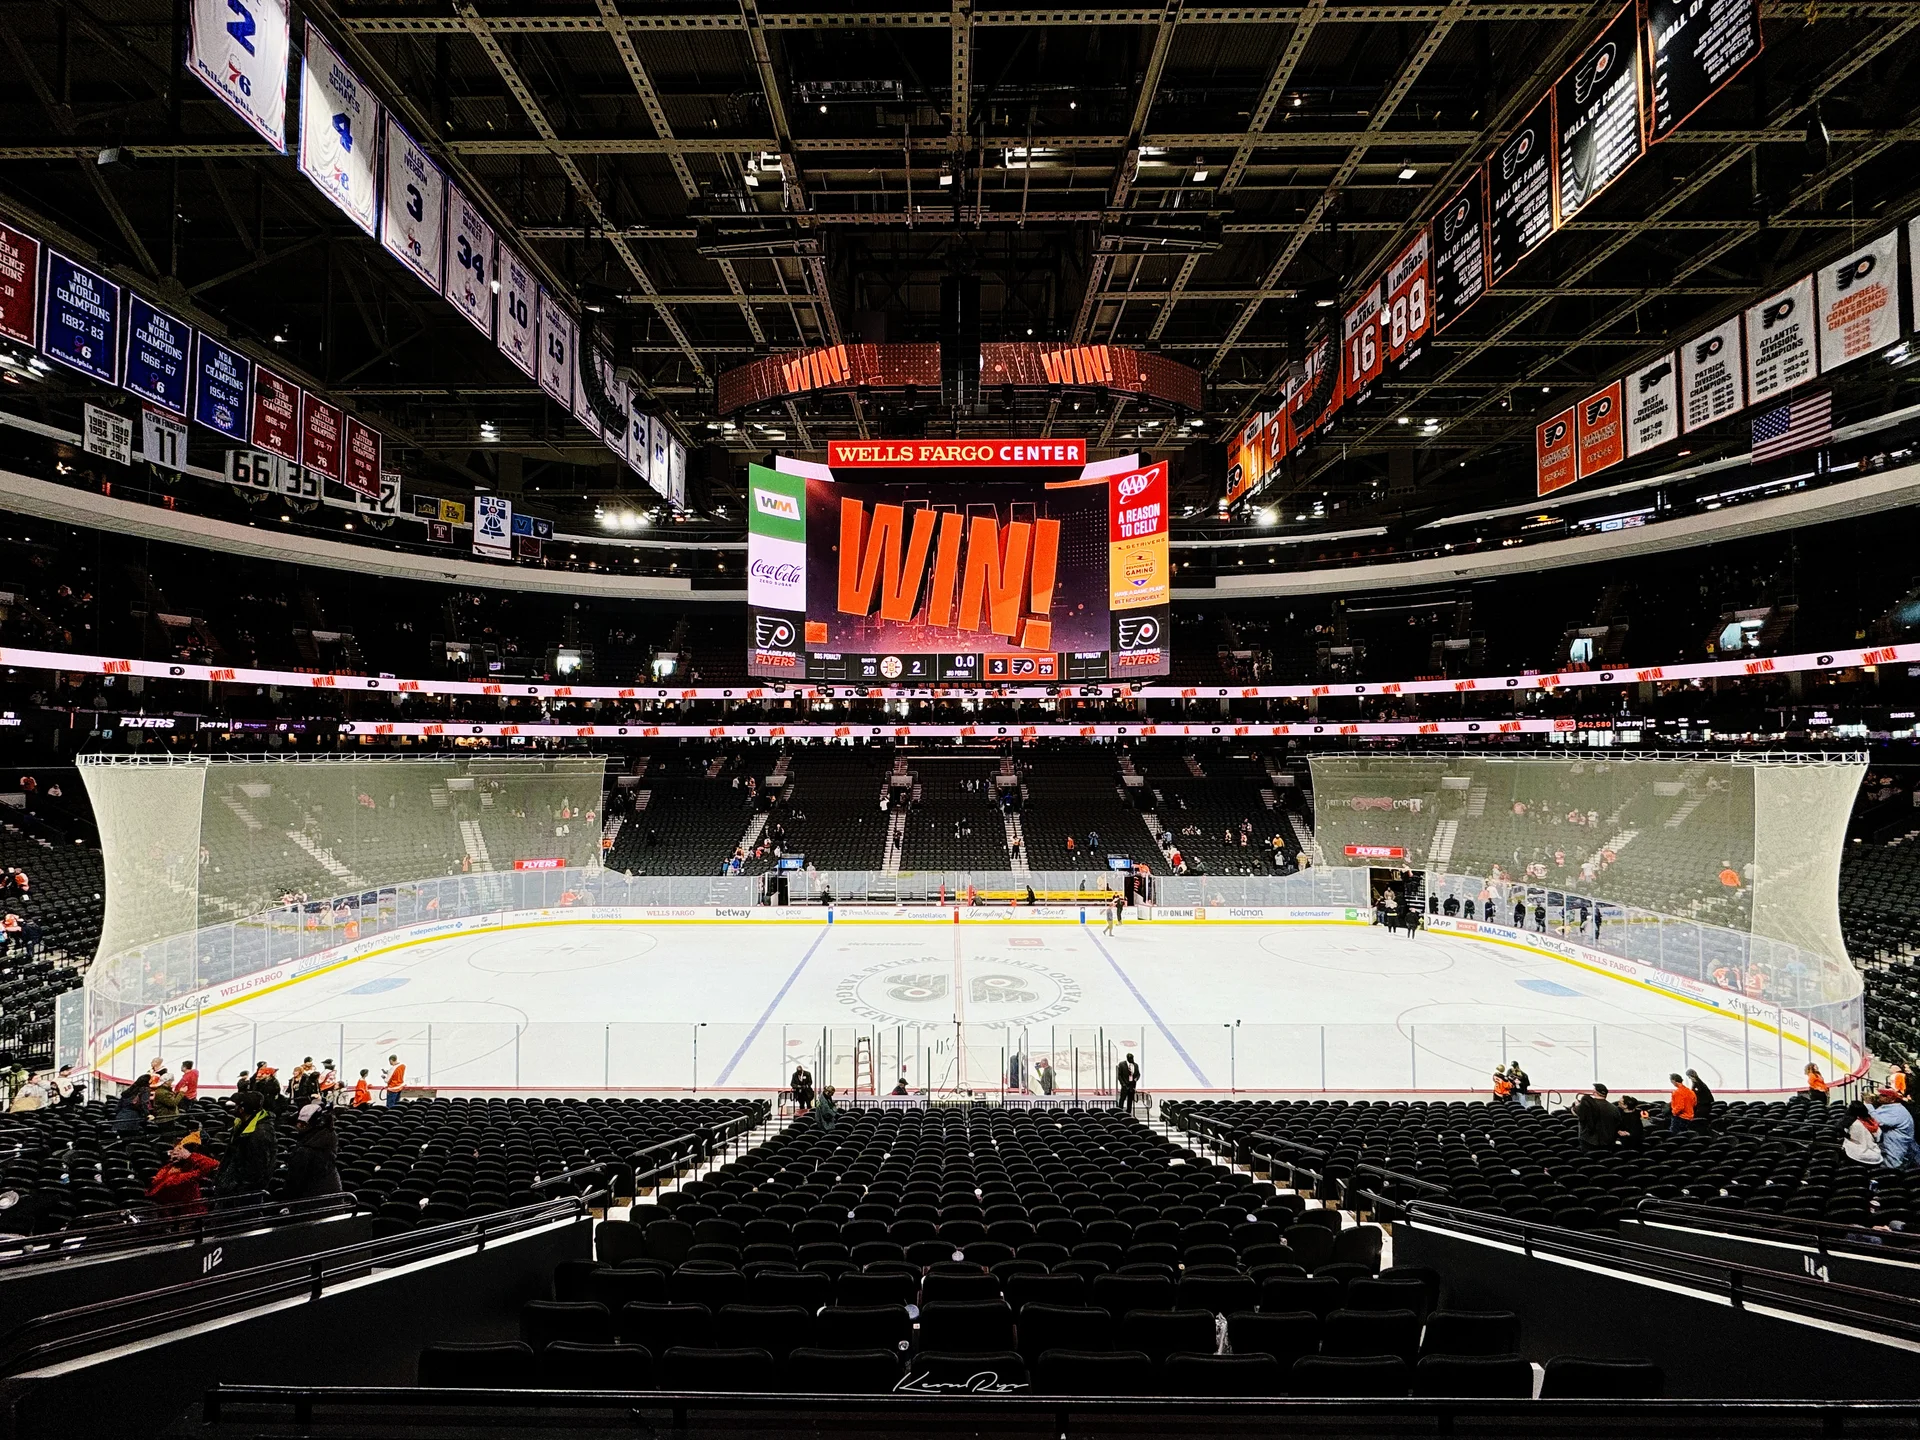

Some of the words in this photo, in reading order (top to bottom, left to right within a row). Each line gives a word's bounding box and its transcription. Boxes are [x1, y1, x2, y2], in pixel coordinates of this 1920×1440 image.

[226, 0, 256, 57] 2
[1658, 13, 1688, 51] HALL
[198, 58, 253, 116] Philadelphia
[228, 60, 251, 97] 76
[1563, 115, 1587, 145] HALL
[1588, 98, 1601, 120] OF
[1602, 67, 1631, 107] FAME
[403, 153, 428, 186] IVERSON
[407, 147, 425, 172] ALLEN
[1495, 189, 1512, 212] HALL
[1512, 176, 1523, 194] OF
[1523, 154, 1546, 184] FAME
[406, 183, 424, 222] 3
[1436, 249, 1453, 269] HALL
[1452, 240, 1461, 256] OF
[1460, 223, 1479, 247] FAME
[457, 234, 485, 285] 34
[1392, 250, 1424, 291] LINDROS
[73, 270, 94, 291] NBA
[69, 280, 100, 305] WORLD
[1831, 281, 1882, 312] CAMPBELL
[56, 287, 111, 323] CHAMPIONS
[508, 290, 528, 330] 10
[1391, 277, 1427, 349] 88
[1826, 286, 1889, 323] CONFERENCE
[1828, 298, 1887, 332] CHAMPIONS
[61, 312, 104, 341] 1982-83
[153, 313, 170, 333] NBA
[1350, 301, 1376, 334] CLARKE
[136, 328, 183, 361] CHAMPIONS
[147, 322, 175, 345] WORLD
[1759, 323, 1800, 349] ATLANTIC
[1761, 333, 1798, 356] DIVISION
[51, 346, 93, 370] Philadelphia
[218, 350, 232, 366] NBA
[548, 331, 565, 366] 13
[1352, 324, 1376, 382] 16
[1755, 338, 1804, 367] CHAMPIONS
[140, 351, 177, 377] 1966-67
[214, 358, 237, 378] WORLD
[782, 344, 851, 393] WIN!
[1040, 344, 1113, 385] WIN!
[1694, 360, 1725, 381] PATRICK
[205, 364, 244, 391] CHAMPIONS
[1690, 373, 1732, 398] CHAMPIONS
[1694, 367, 1726, 389] DIVISION
[209, 385, 239, 407] 1954-55
[1642, 393, 1659, 407] WEST
[1633, 404, 1669, 425] CHAMPIONS
[1637, 399, 1664, 417] DIVISION
[632, 420, 646, 447] 32
[1270, 420, 1280, 458] 2
[154, 426, 177, 467] 11
[835, 445, 914, 462] WELLS
[918, 445, 995, 462] FARGO
[999, 445, 1080, 462] CENTER
[232, 451, 271, 488] 66
[286, 461, 317, 497] 35
[1121, 476, 1146, 495] AAA
[480, 495, 506, 508] BIG
[761, 495, 794, 514] WM
[1118, 511, 1126, 525] A
[1126, 502, 1161, 523] REASON
[1120, 524, 1133, 538] TO
[1133, 518, 1159, 536] CELLY
[1125, 538, 1166, 550] BETRIVERS
[751, 558, 803, 584] Coca-Cola
[838, 497, 1061, 651] WIN!
[1125, 567, 1154, 576] GAMING
[755, 648, 796, 658] PHILADELPHIA
[755, 653, 796, 668] FLYERS
[955, 655, 975, 668] 0.0
[1118, 654, 1160, 667] FLYERS
[1119, 647, 1161, 657] PHILADELPHIA
[863, 665, 875, 675] 20
[912, 661, 921, 674] 2
[994, 660, 1003, 673] 3
[1040, 665, 1052, 674] 29
[119, 717, 176, 728] FLYERS
[216, 721, 229, 729] PM
[1616, 720, 1631, 728] 3:47
[1631, 720, 1644, 728] PM
[1808, 717, 1834, 725] PENALTY
[1889, 711, 1916, 719] SHOTS
[1355, 846, 1391, 857] FLYERS
[522, 859, 558, 869] FLYERS
[646, 909, 671, 917] WELLS
[671, 909, 696, 917] FARGO
[715, 907, 752, 919] betway
[785, 908, 802, 917] peco
[863, 909, 889, 917] Medicine
[907, 911, 947, 920] Constellation
[966, 908, 1004, 919] Yuengling
[1157, 909, 1169, 917] PLAY
[1169, 909, 1194, 917] ONLINE
[1229, 908, 1264, 917] Holman
[1289, 910, 1331, 918] ticketmaster
[409, 923, 455, 937] Independence
[1478, 925, 1518, 940] AMAZING
[1538, 936, 1576, 956] NovaCare
[1582, 951, 1608, 967] WELLS
[1608, 960, 1637, 975] FARGO
[220, 979, 253, 998] WELLS
[253, 970, 283, 987] FARGO
[159, 993, 211, 1019] NovaCare
[983, 1003, 1073, 1031] WELLS
[850, 1005, 940, 1032] CENTER
[203, 1247, 222, 1273] 112
[1804, 1255, 1829, 1282] 114
